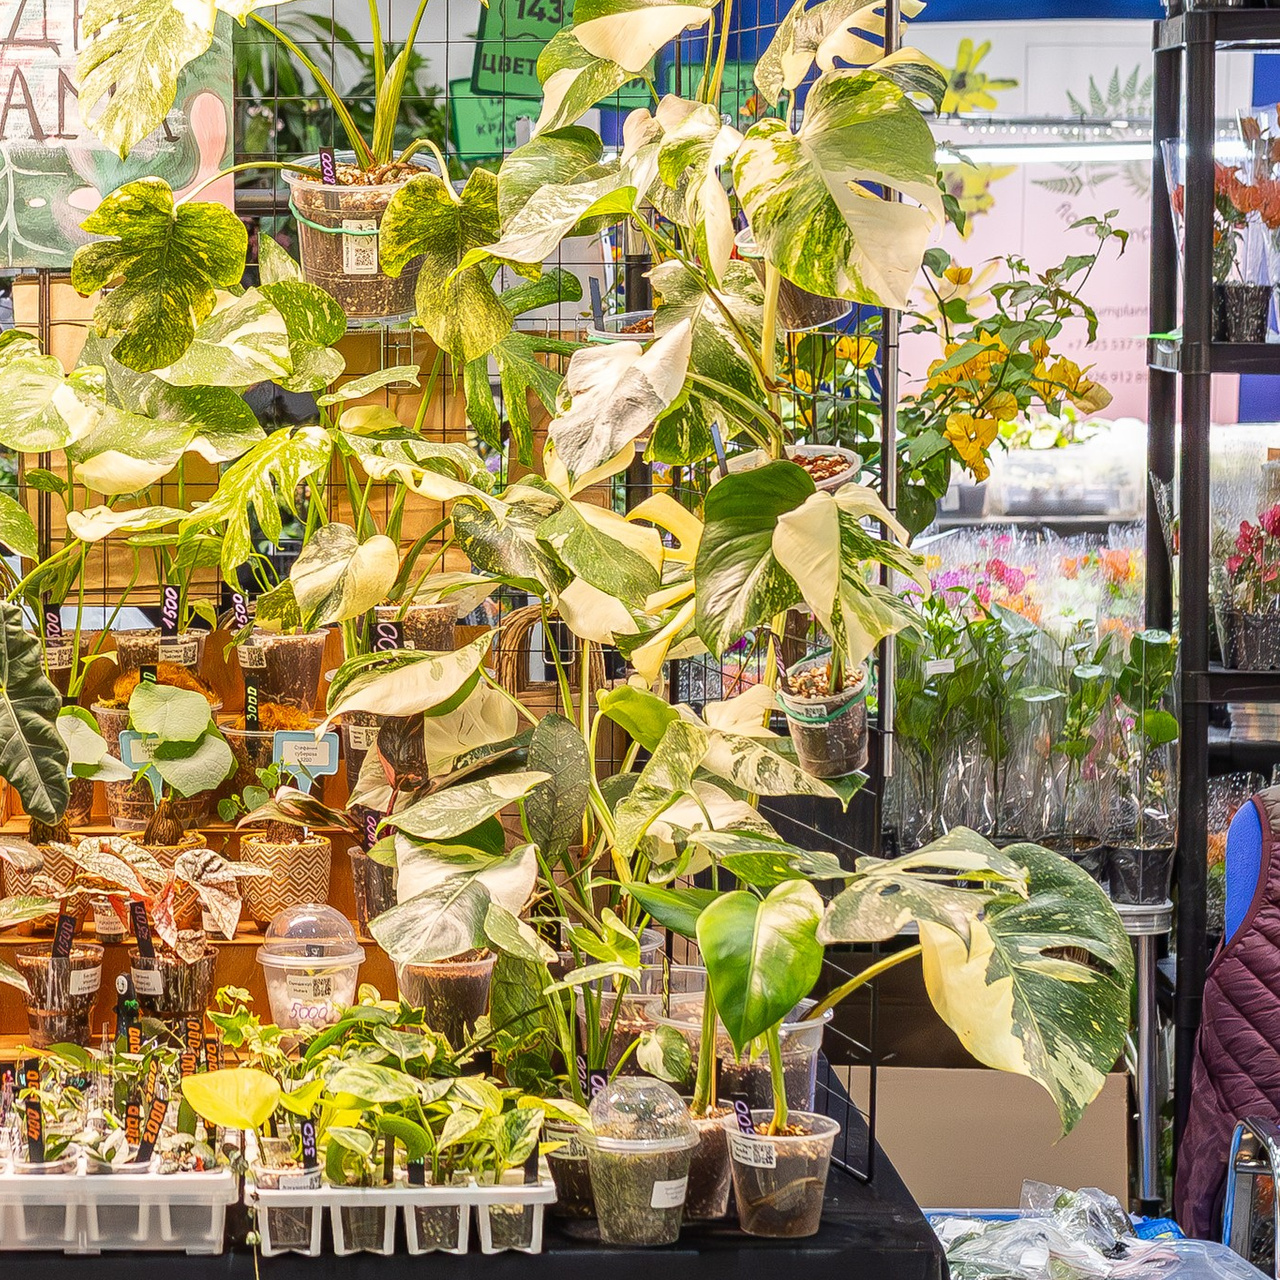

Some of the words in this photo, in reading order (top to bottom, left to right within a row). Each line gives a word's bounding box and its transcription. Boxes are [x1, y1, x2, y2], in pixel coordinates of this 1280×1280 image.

[162, 586, 178, 629] 1500
[246, 686, 258, 721] 3000
[289, 1002, 328, 1020] 5000
[143, 1099, 167, 1144] 2000
[303, 1121, 314, 1157] 350
